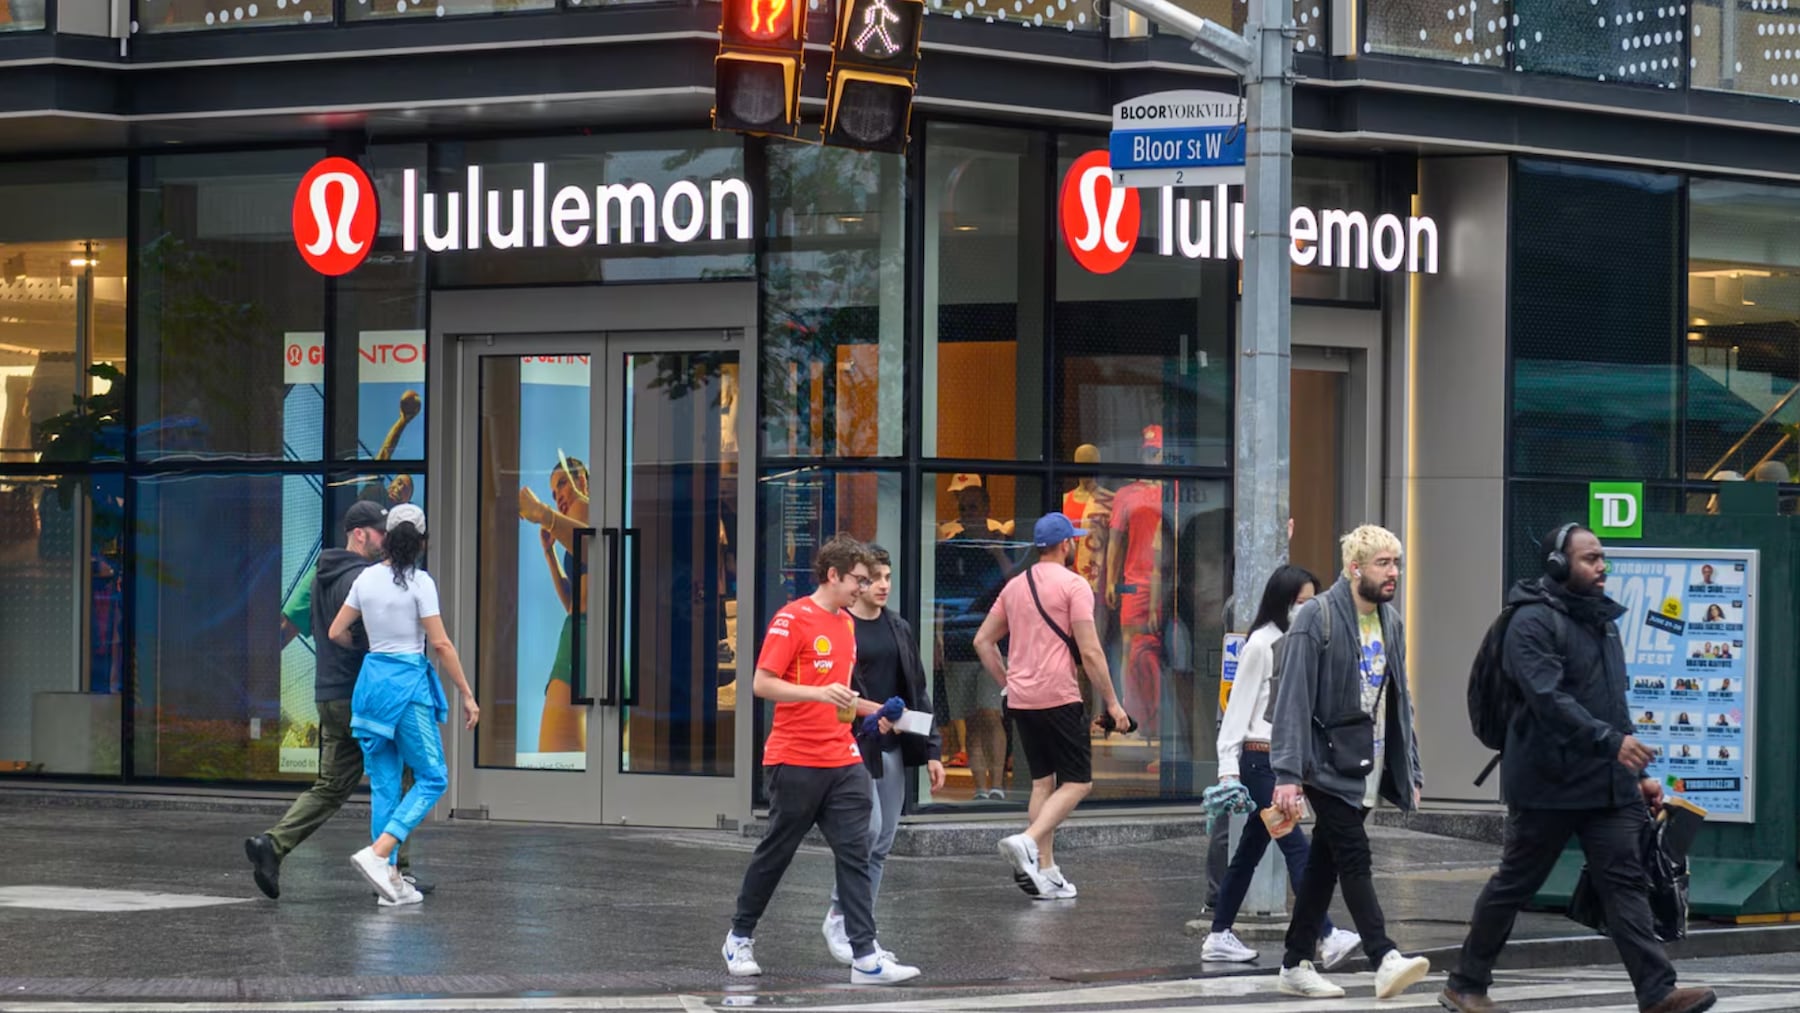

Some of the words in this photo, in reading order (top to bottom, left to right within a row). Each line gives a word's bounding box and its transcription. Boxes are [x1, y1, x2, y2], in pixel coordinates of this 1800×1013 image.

[1133, 136, 1183, 162] Bloor
[1187, 139, 1201, 159] St
[1205, 133, 1222, 159] W
[1176, 171, 1183, 184] 2
[403, 162, 753, 252] lululemon
[1158, 184, 1439, 273] lulemon
[1594, 493, 1637, 527] TD
